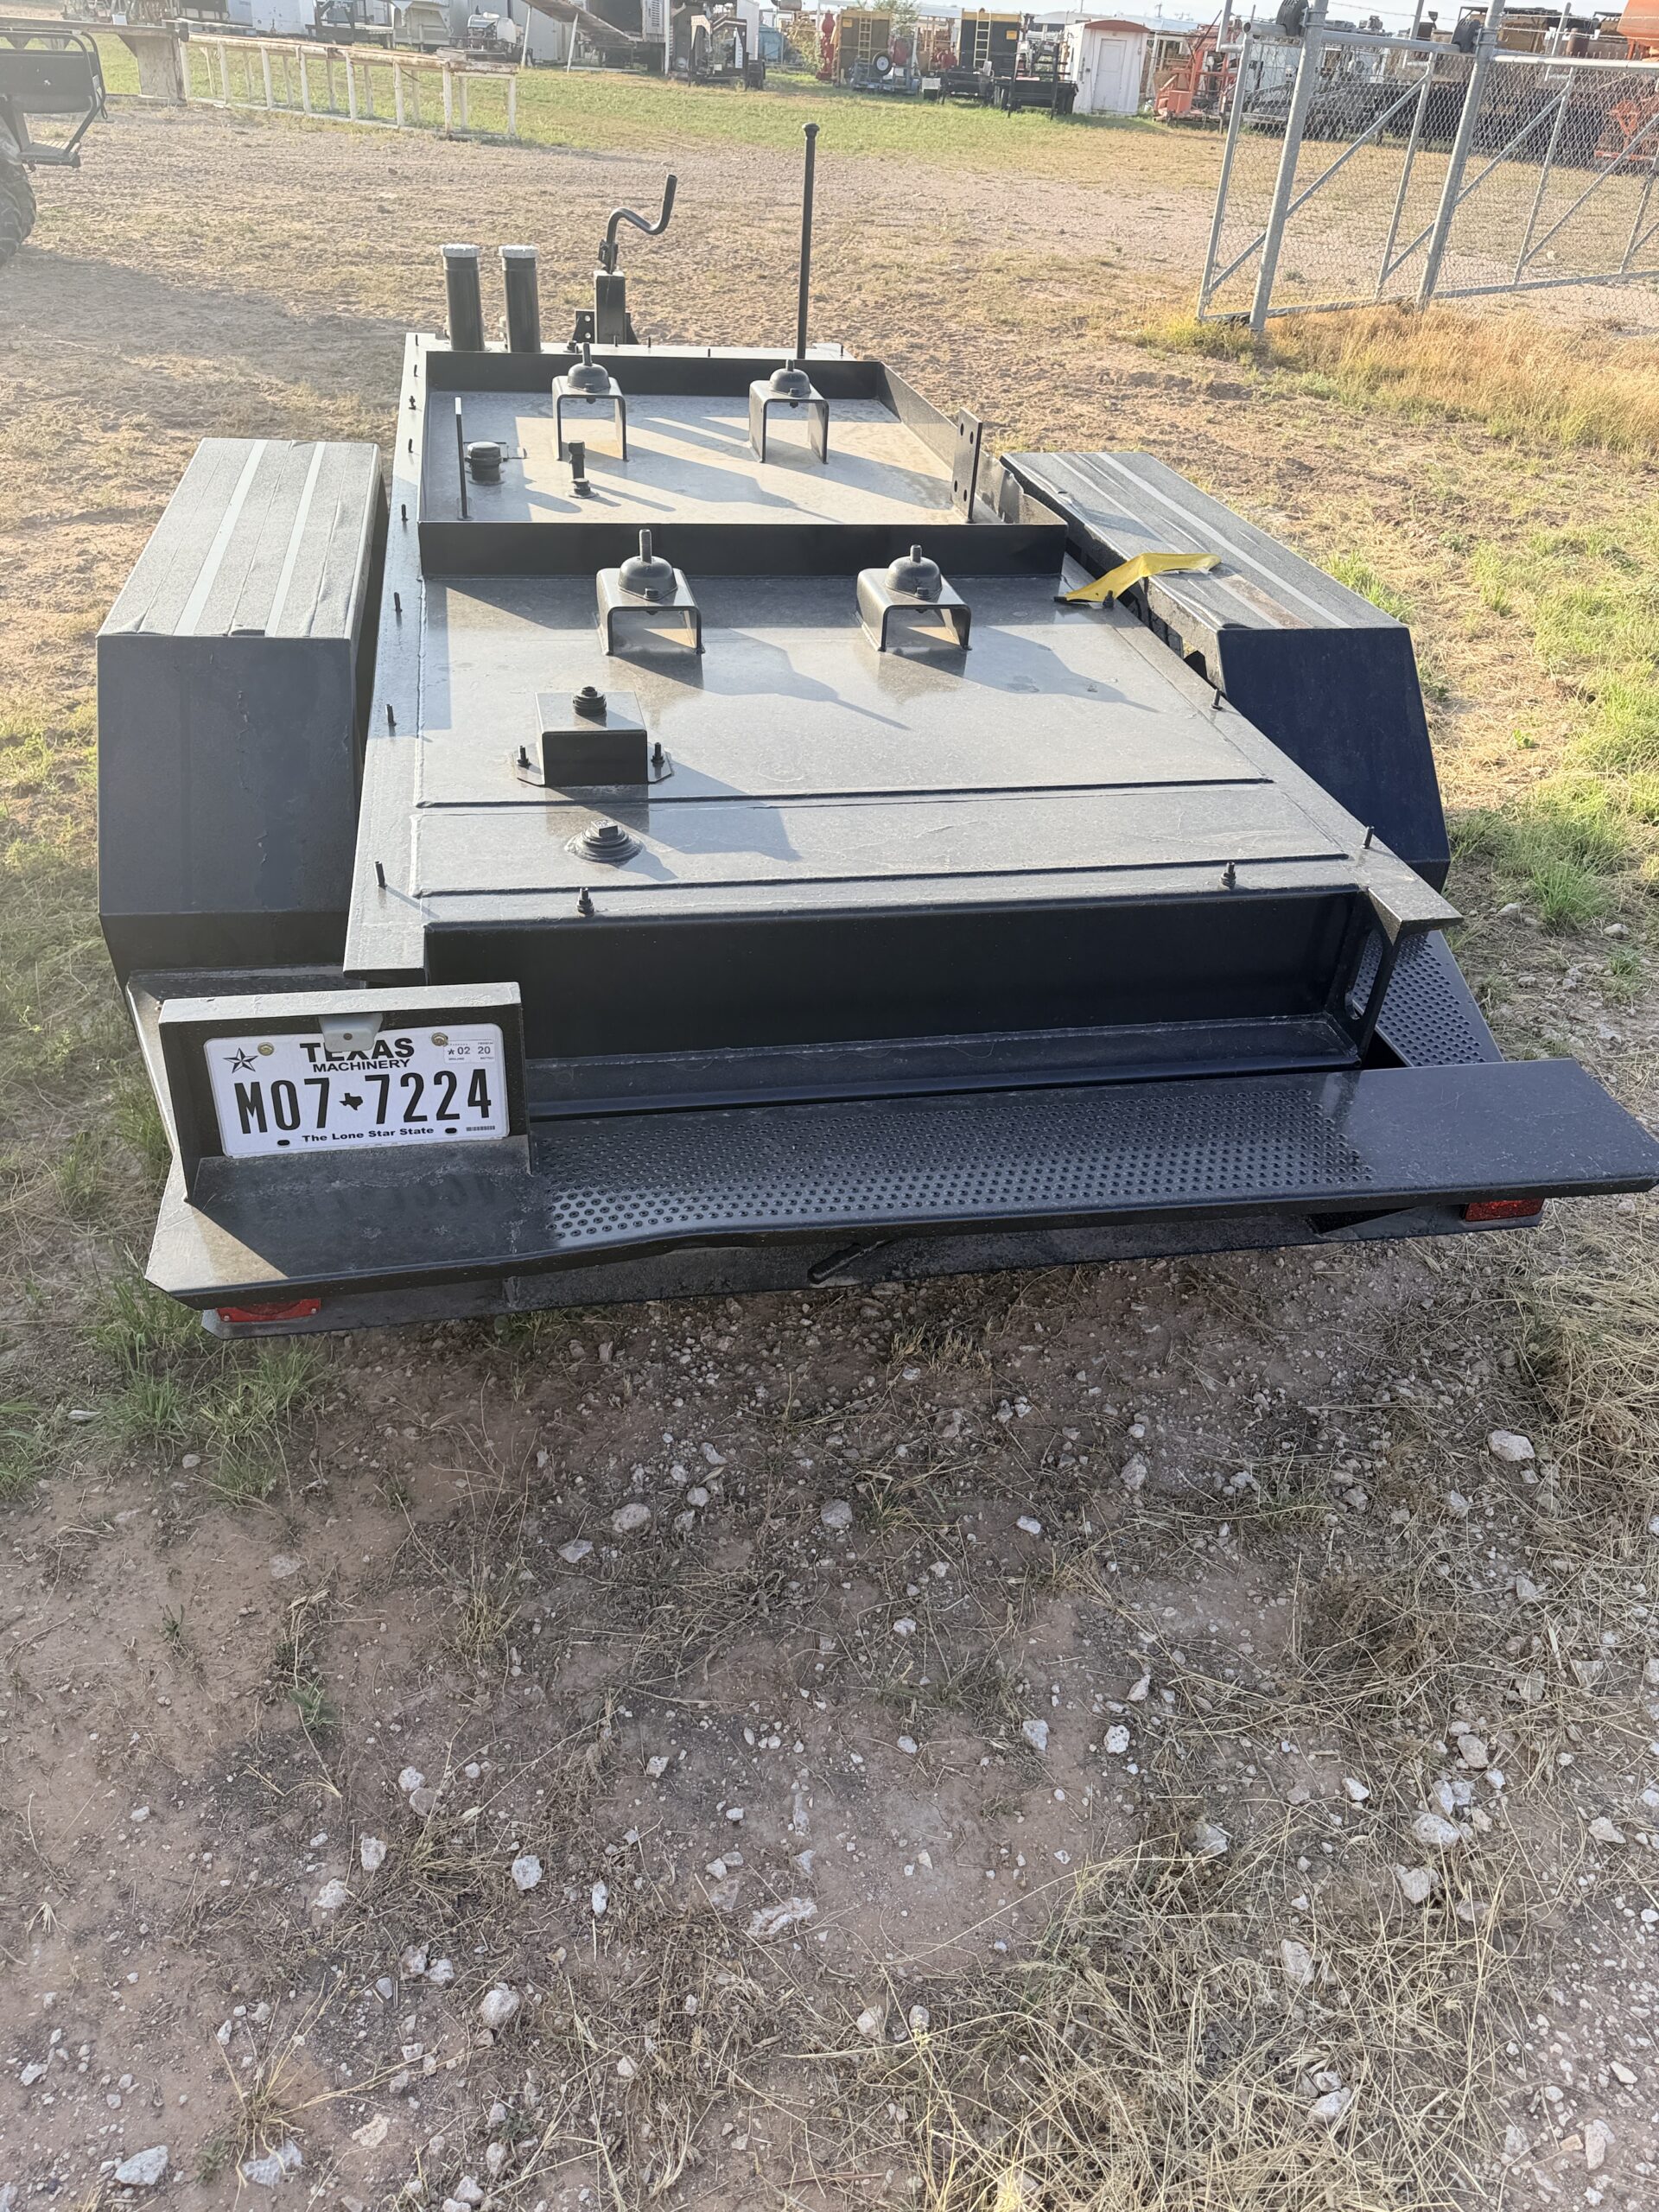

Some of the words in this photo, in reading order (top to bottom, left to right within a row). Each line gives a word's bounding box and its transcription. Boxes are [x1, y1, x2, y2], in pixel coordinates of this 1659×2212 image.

[457, 1046, 471, 1055] 02
[477, 1046, 491, 1055] 20
[312, 1058, 410, 1073] MACHINERY
[364, 1068, 492, 1125] 7224
[302, 1134, 327, 1143] The
[332, 1132, 364, 1141] Lone
[368, 1128, 396, 1138] Star
[399, 1127, 435, 1136] State
